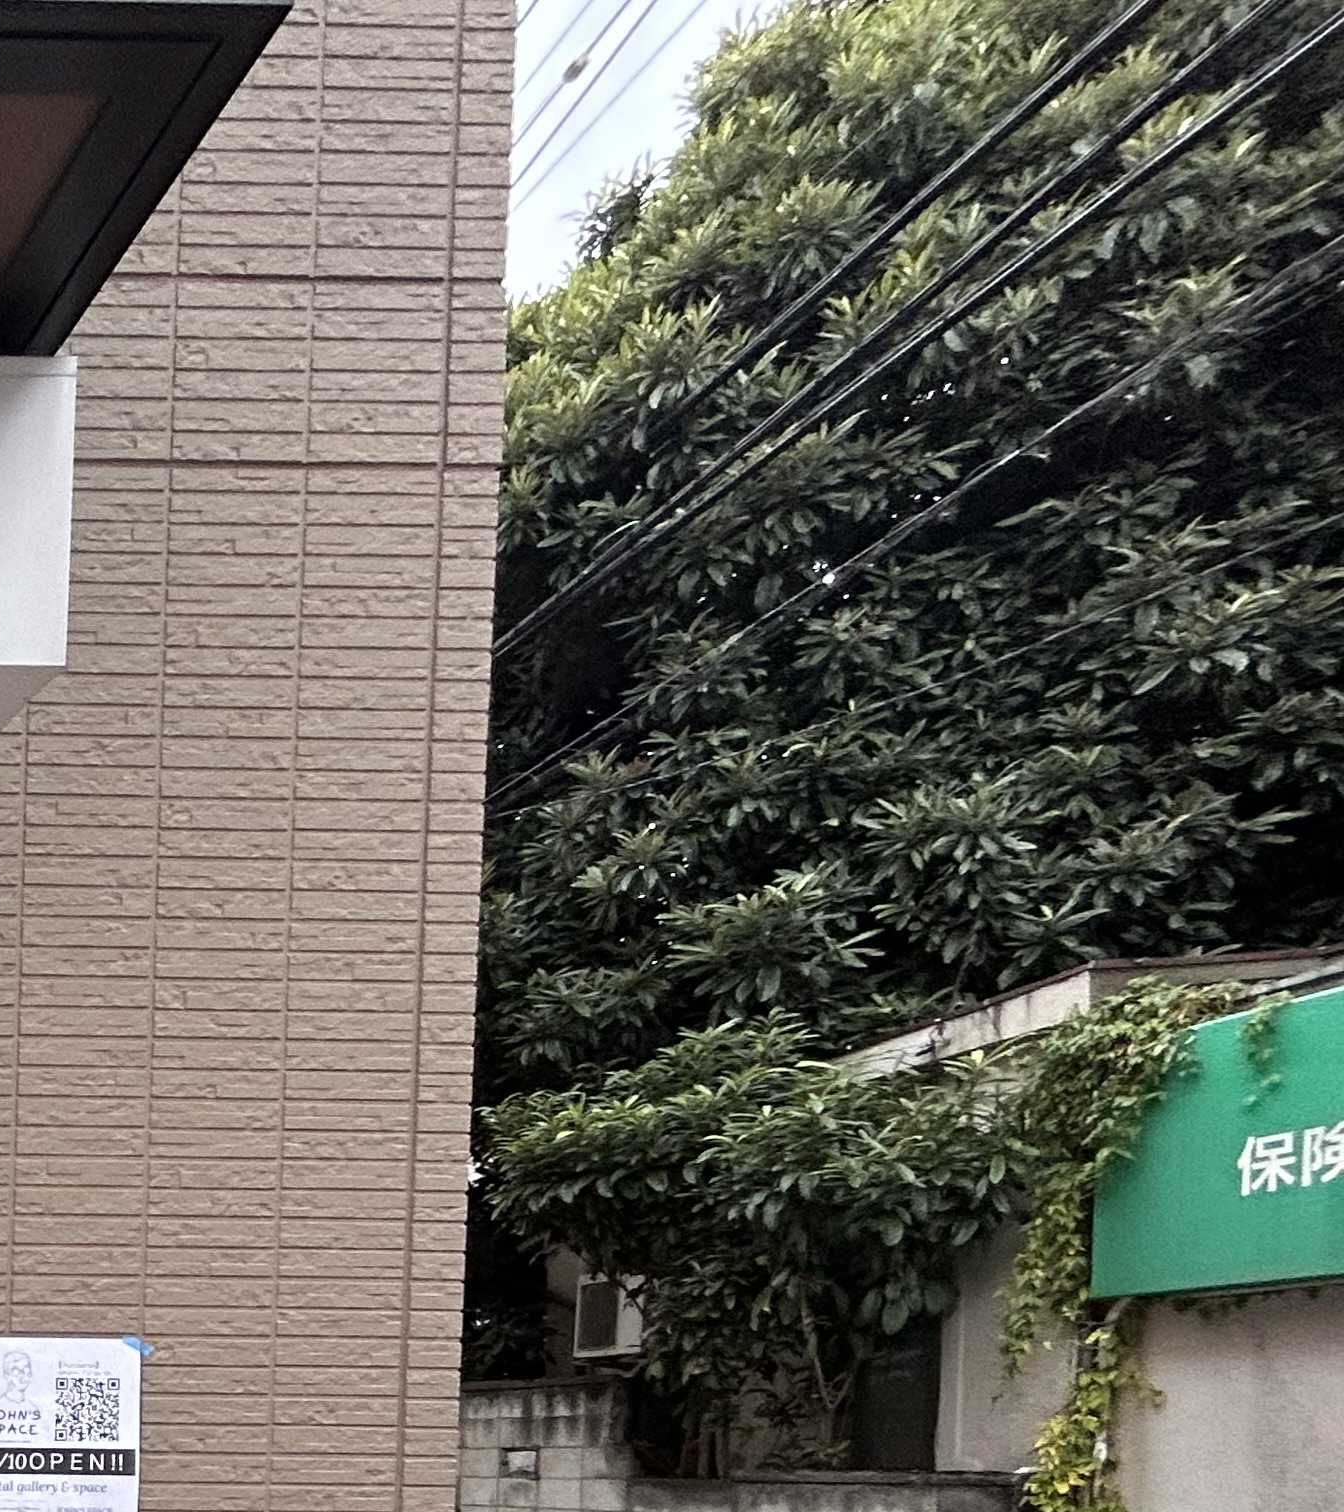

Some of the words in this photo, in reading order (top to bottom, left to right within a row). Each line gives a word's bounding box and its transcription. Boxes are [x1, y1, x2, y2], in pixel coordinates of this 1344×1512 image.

[1237, 1120, 1344, 1197] 保険
[16, 1481, 58, 1494] gallery
[61, 1482, 70, 1492] &
[73, 1484, 108, 1495] space
